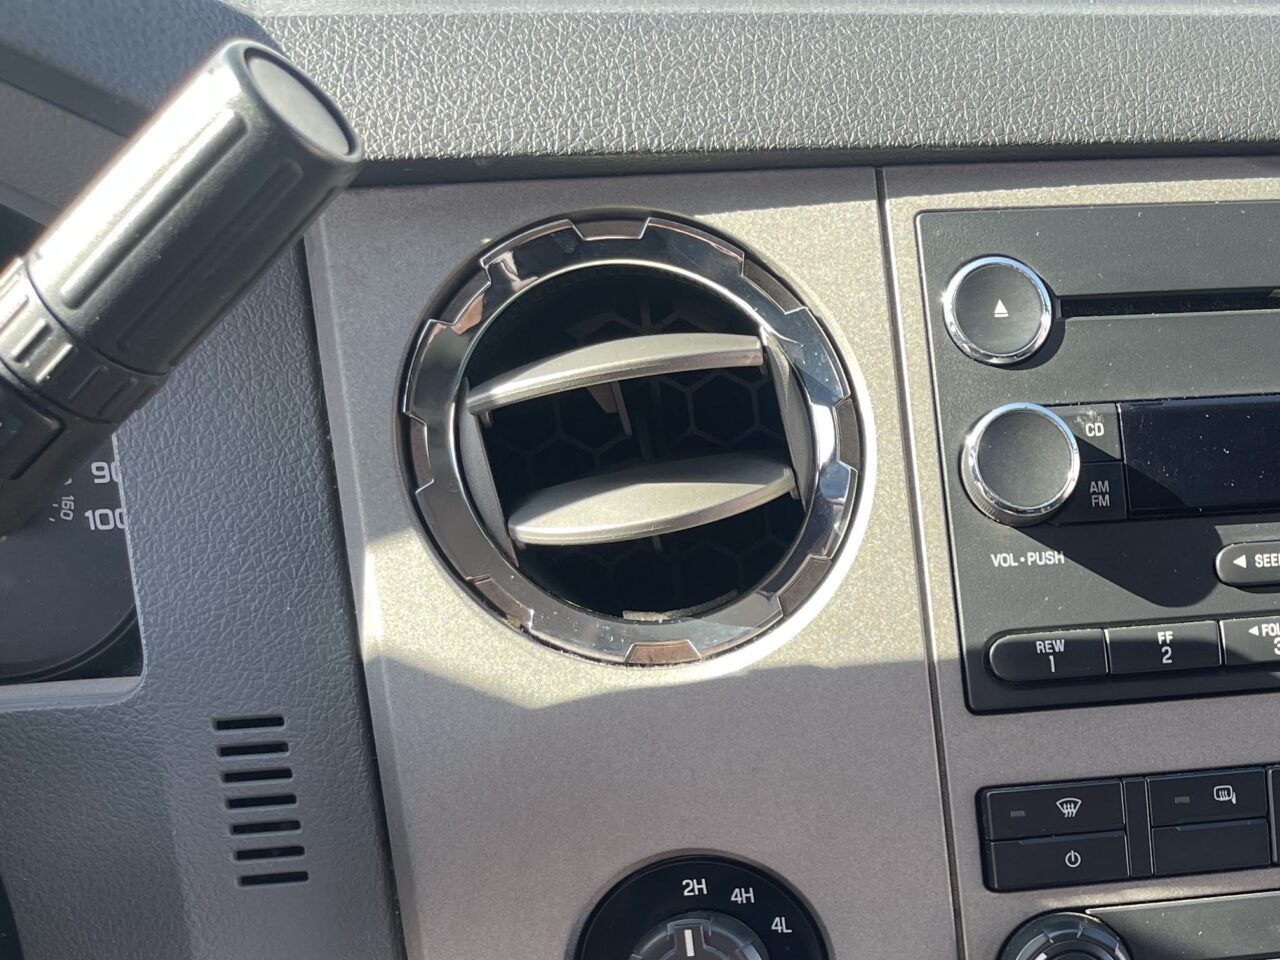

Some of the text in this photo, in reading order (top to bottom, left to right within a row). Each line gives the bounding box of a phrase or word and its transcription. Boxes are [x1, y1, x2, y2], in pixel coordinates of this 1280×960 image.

[1085, 422, 1105, 437] CD
[1089, 480, 1109, 493] AM
[60, 495, 75, 520] 160
[1091, 494, 1111, 507] FM
[1035, 639, 1065, 653] REW
[1157, 631, 1174, 645] FF
[1161, 646, 1173, 664] 2
[1048, 655, 1056, 673] 1
[682, 879, 707, 896] 2H
[730, 887, 755, 904] 4H
[771, 917, 792, 933] 4L
